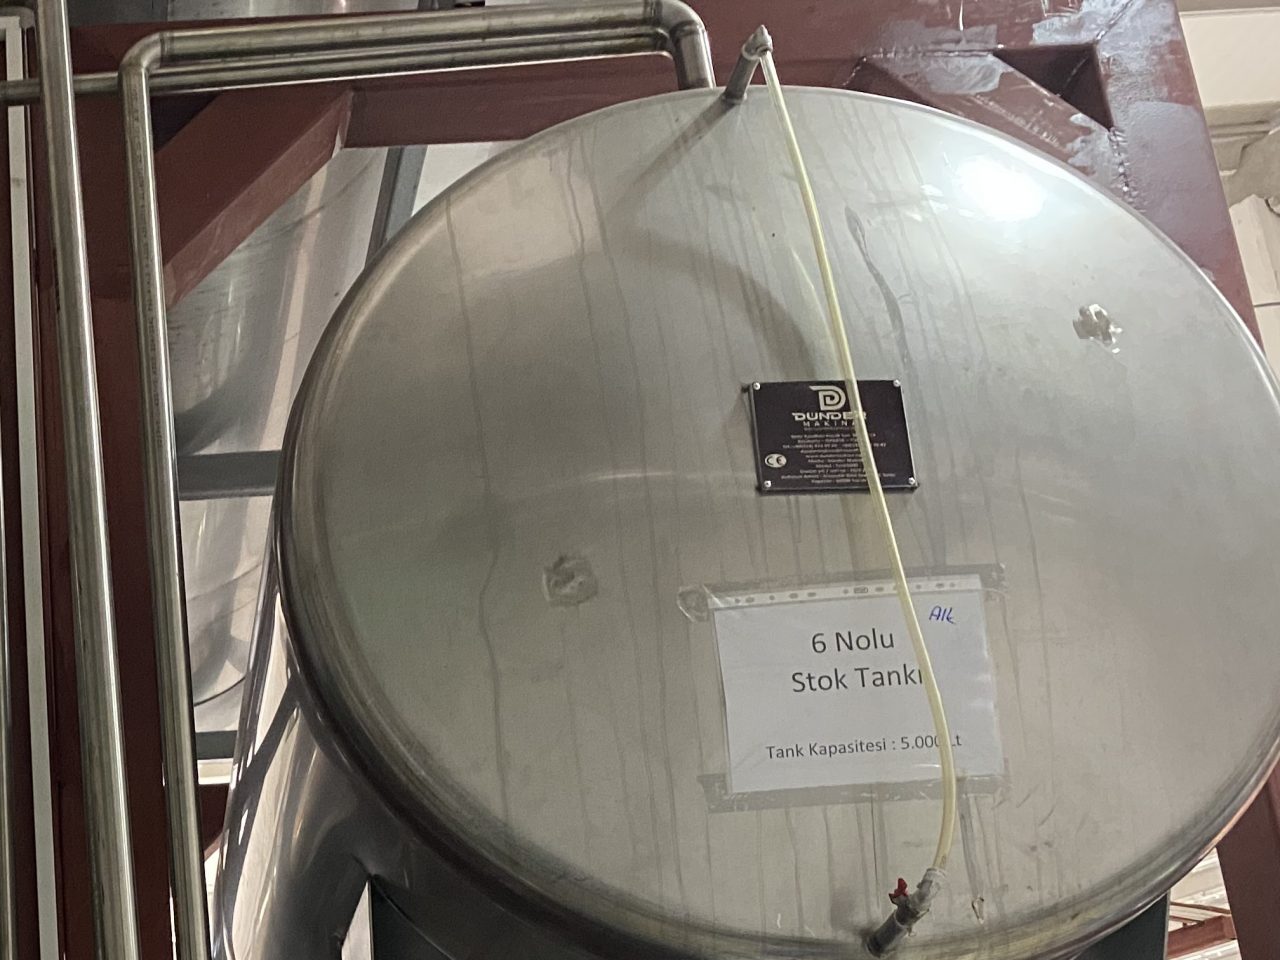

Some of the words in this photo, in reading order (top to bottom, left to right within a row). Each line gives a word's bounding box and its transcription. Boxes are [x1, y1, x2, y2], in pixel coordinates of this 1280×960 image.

[811, 632, 826, 654] 6
[835, 627, 895, 652] Nolu
[791, 667, 848, 693] Stok
[766, 743, 805, 760] Tank
[809, 737, 887, 758] Kapasitesi
